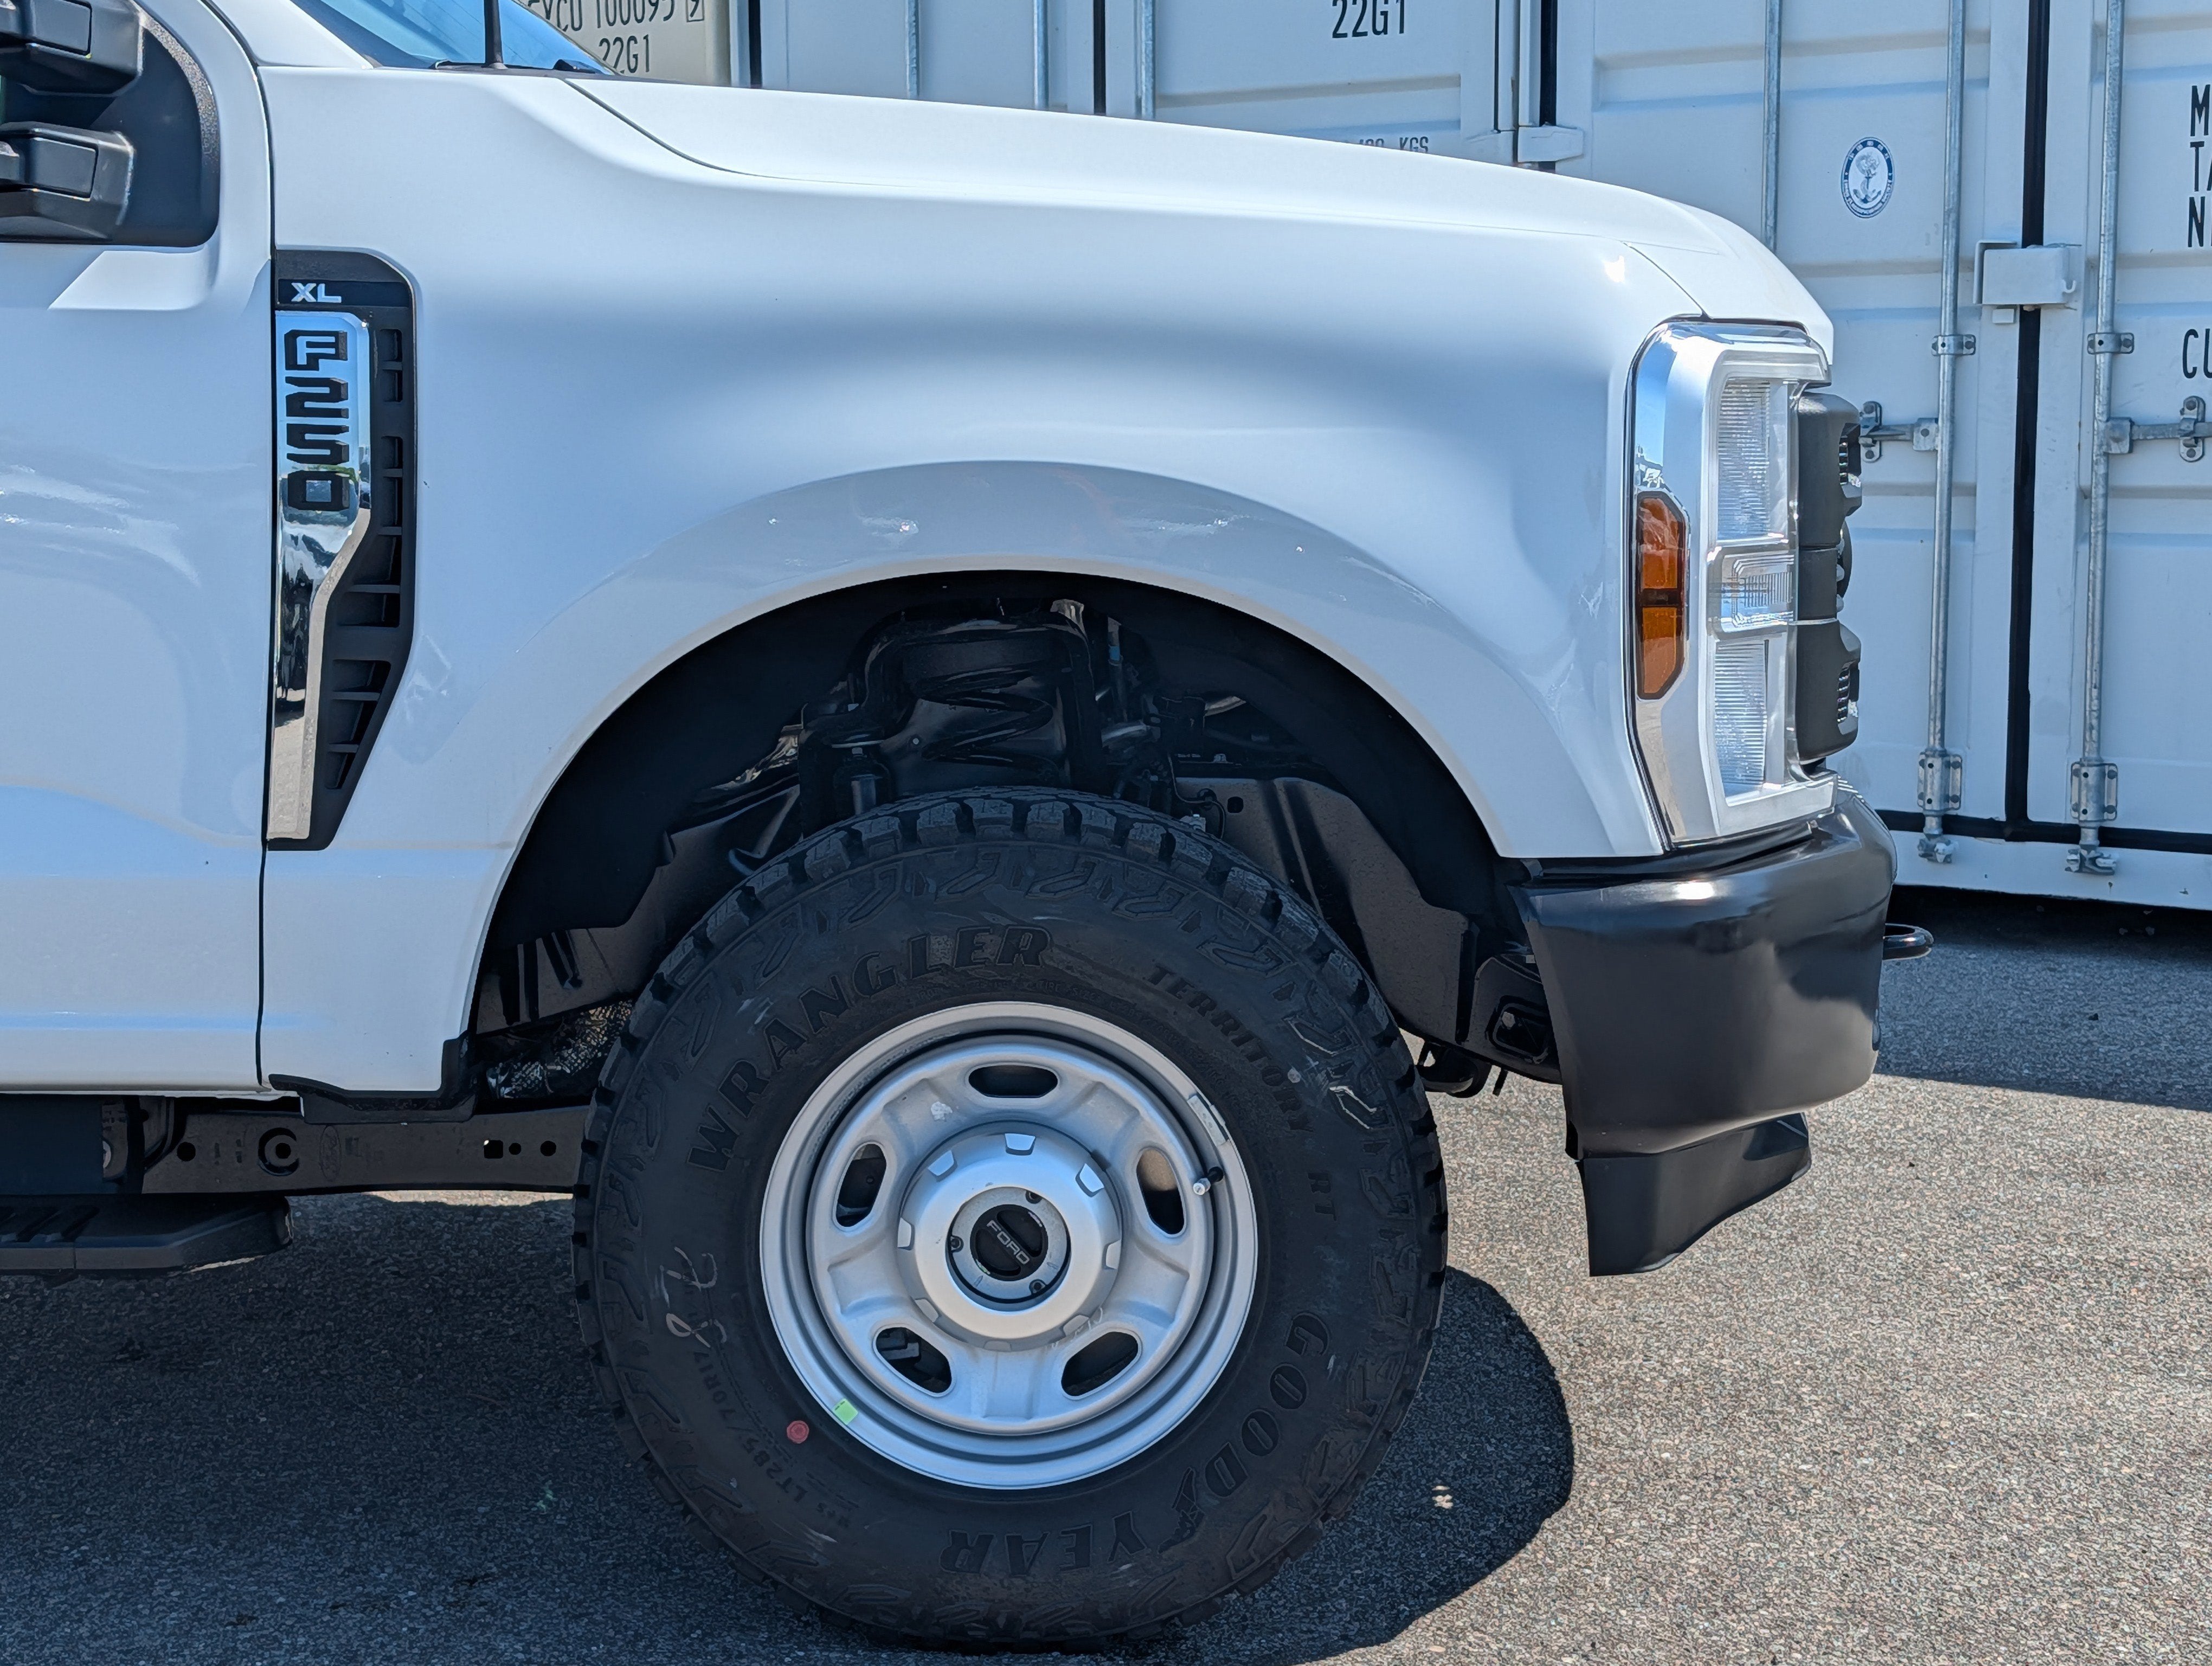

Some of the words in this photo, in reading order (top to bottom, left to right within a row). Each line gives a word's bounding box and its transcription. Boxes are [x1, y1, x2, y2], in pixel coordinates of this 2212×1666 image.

[528, 0, 583, 31] YCU
[1332, 0, 1405, 39] 22G1
[599, 34, 650, 74] 22G1
[1399, 136, 1429, 153] KGS
[2190, 140, 2212, 192] T
[291, 282, 342, 303] XL
[284, 329, 350, 511] F250
[686, 925, 1055, 1172] WRANGLER
[1143, 963, 1314, 1132] TERRITORY
[986, 1220, 1030, 1265] FORD
